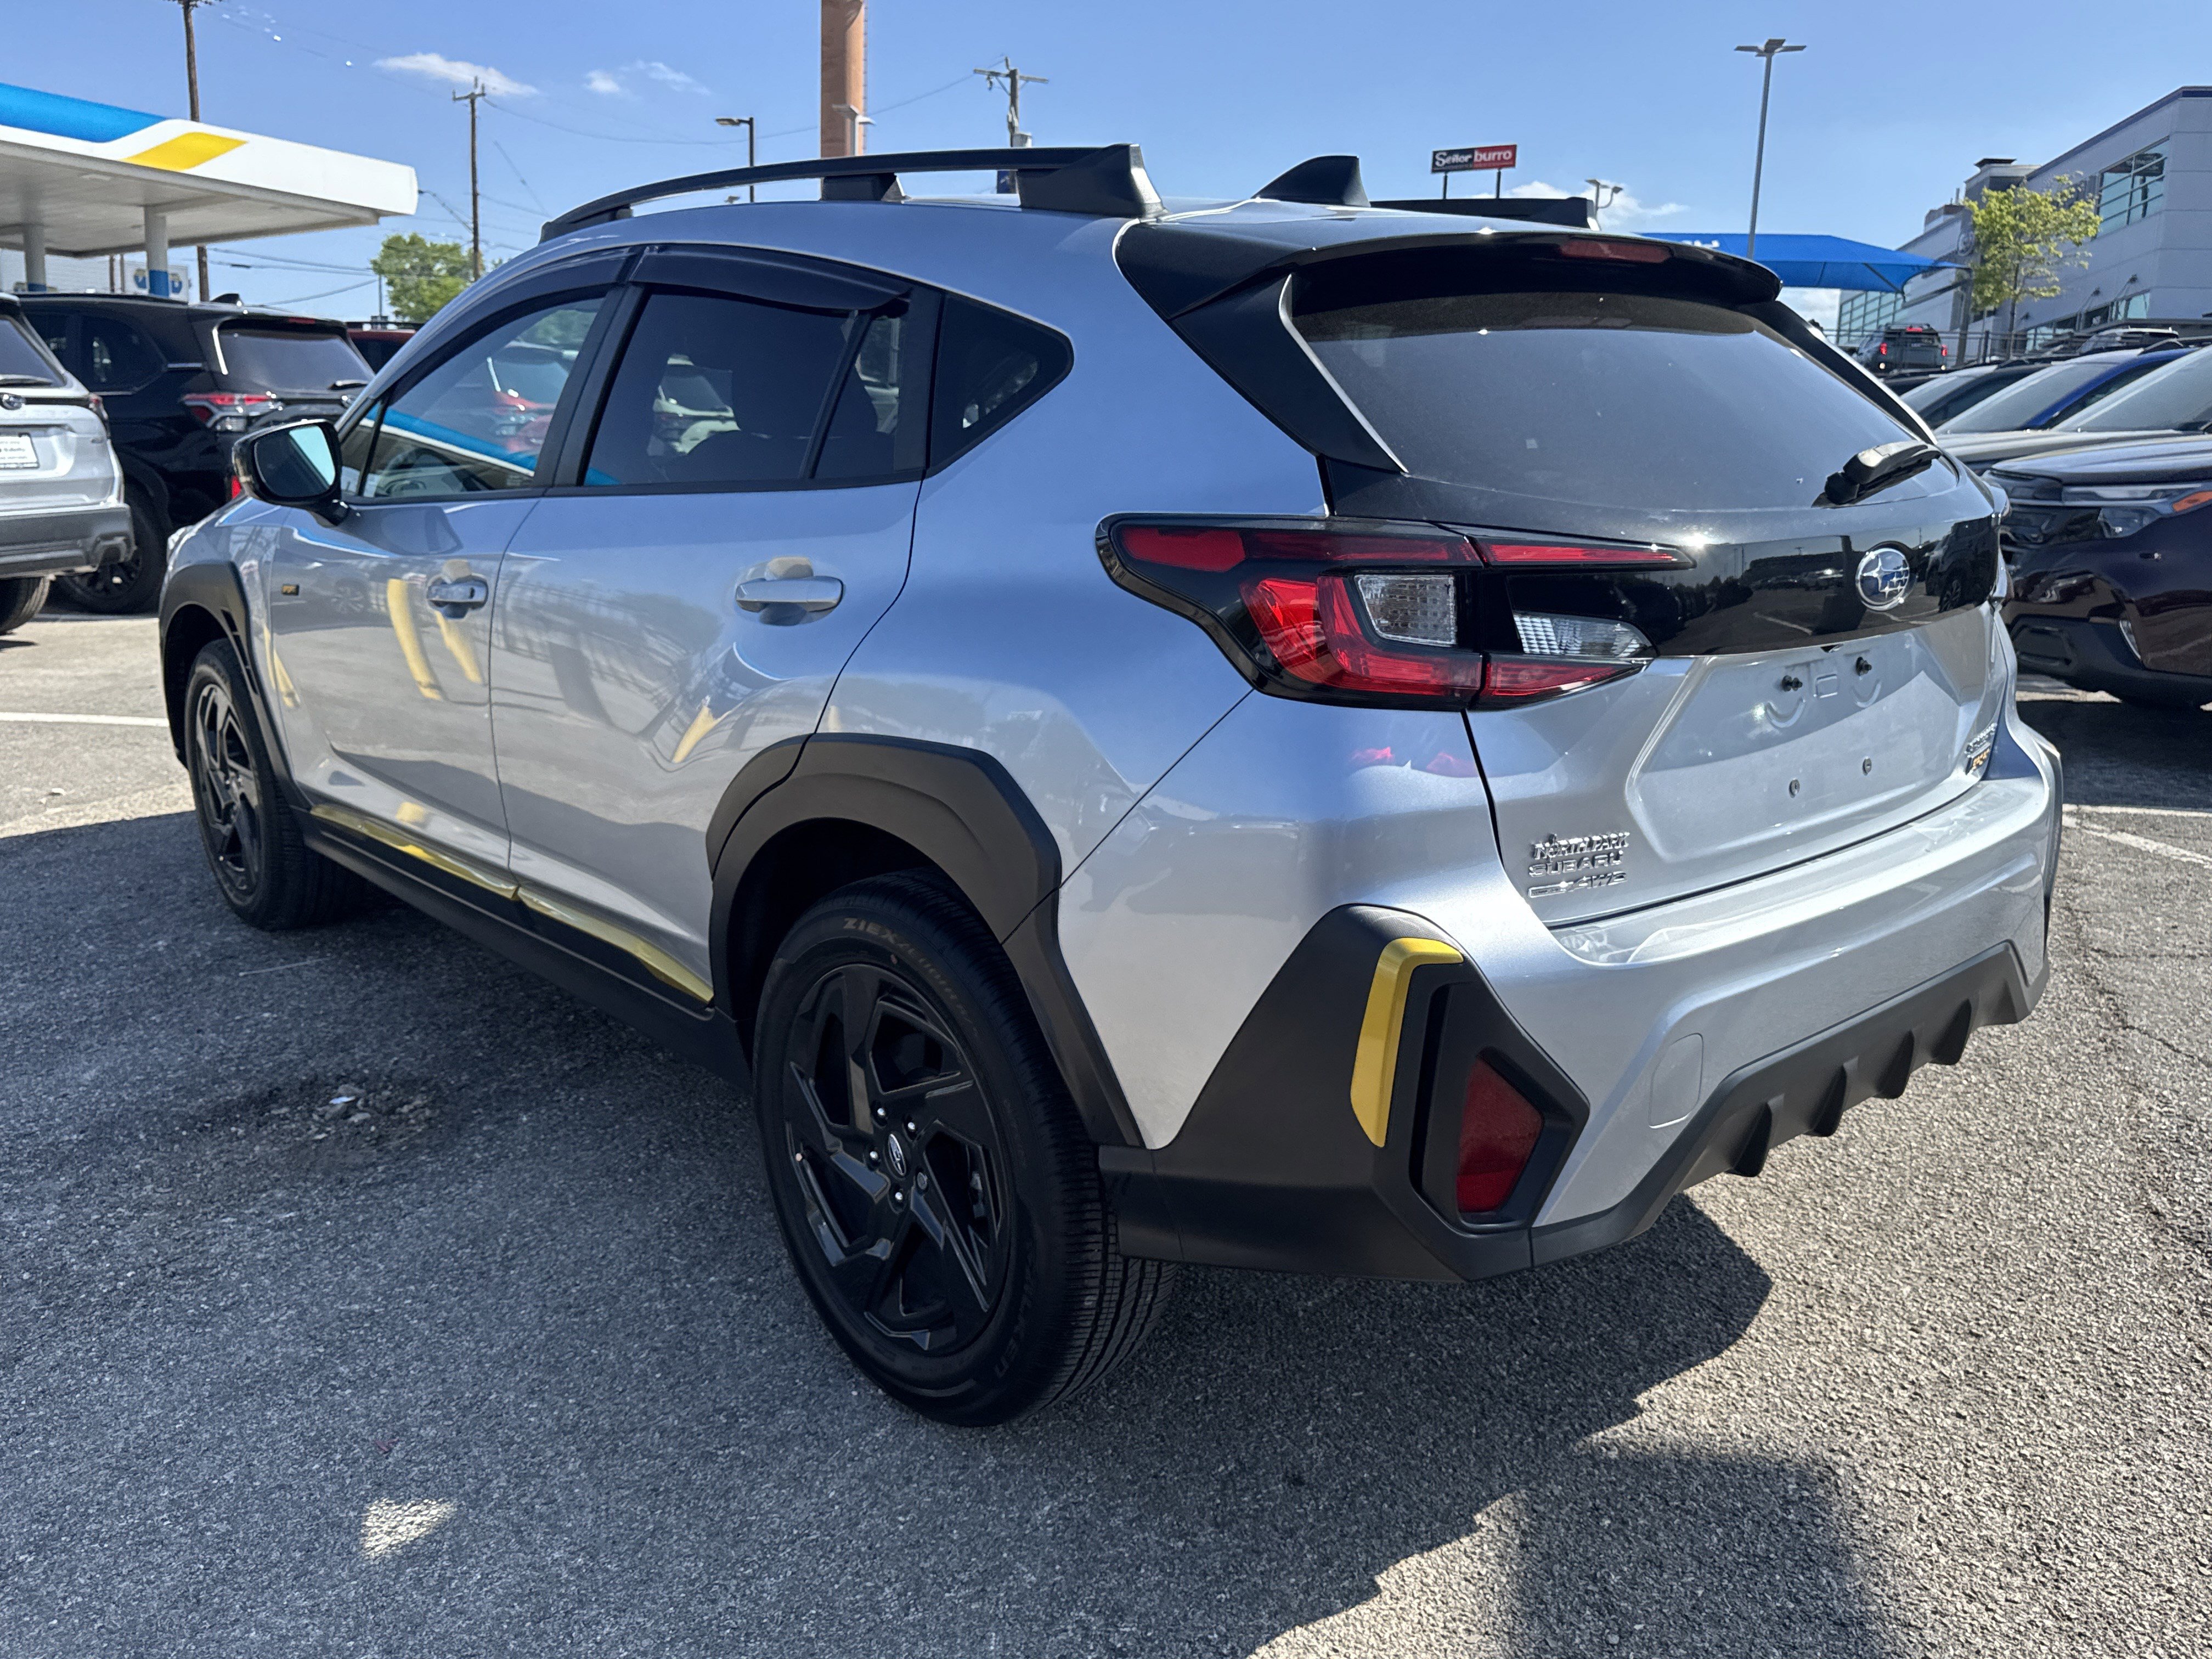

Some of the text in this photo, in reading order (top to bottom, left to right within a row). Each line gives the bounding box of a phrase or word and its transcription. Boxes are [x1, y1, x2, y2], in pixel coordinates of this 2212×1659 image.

[1474, 150, 1512, 162] burro
[1534, 832, 1630, 860] NORTH PARK
[1528, 850, 1623, 877] SUBARU
[1568, 871, 1627, 891] AWD
[843, 917, 899, 944] ZIEX
